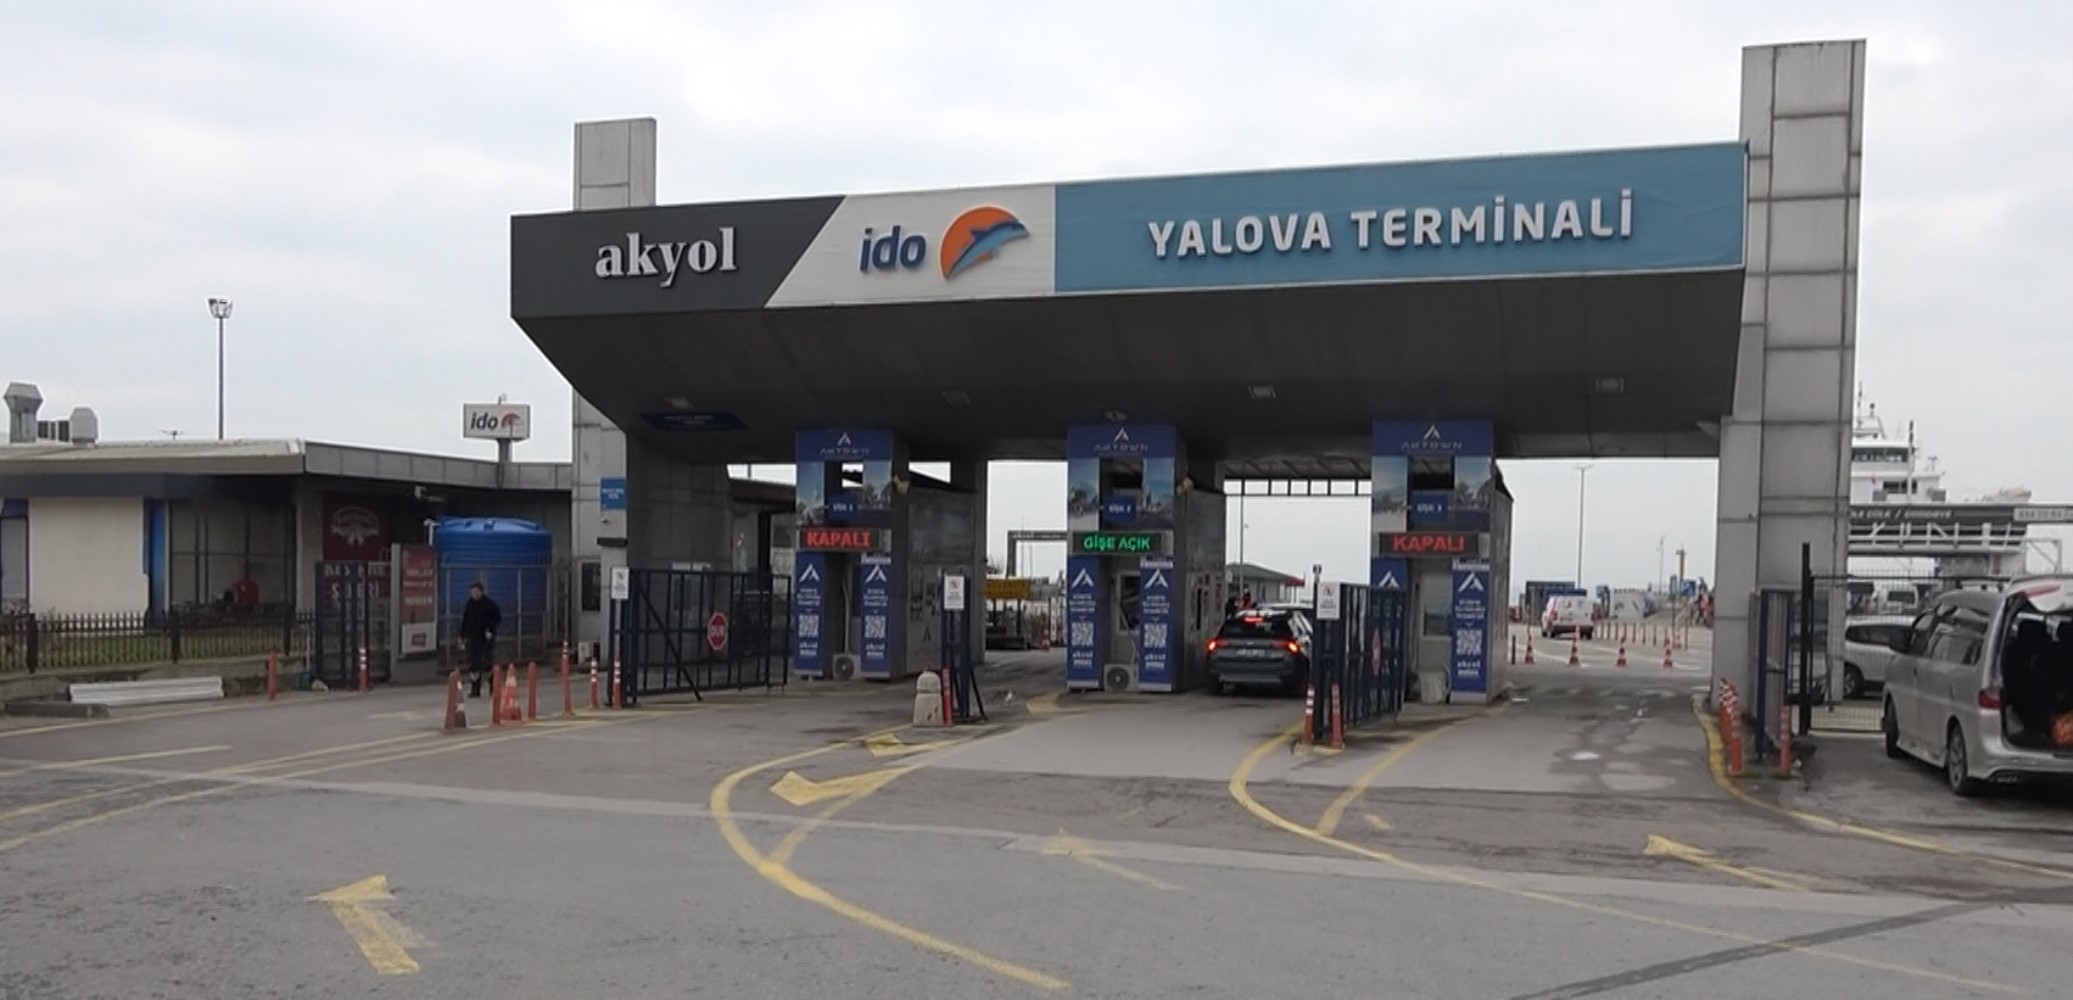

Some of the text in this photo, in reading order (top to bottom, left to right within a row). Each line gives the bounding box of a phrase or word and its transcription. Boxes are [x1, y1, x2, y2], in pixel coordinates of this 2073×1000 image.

[1148, 188, 1634, 259] YALOVA TERMİNALİ
[594, 227, 738, 288] akyol
[859, 224, 927, 273] ido
[470, 412, 498, 430] ido
[806, 531, 871, 548] KAPALI
[1083, 534, 1151, 551] GİŞE AÇIK
[1393, 535, 1465, 553] KAPALI
[711, 624, 725, 638] DUR
